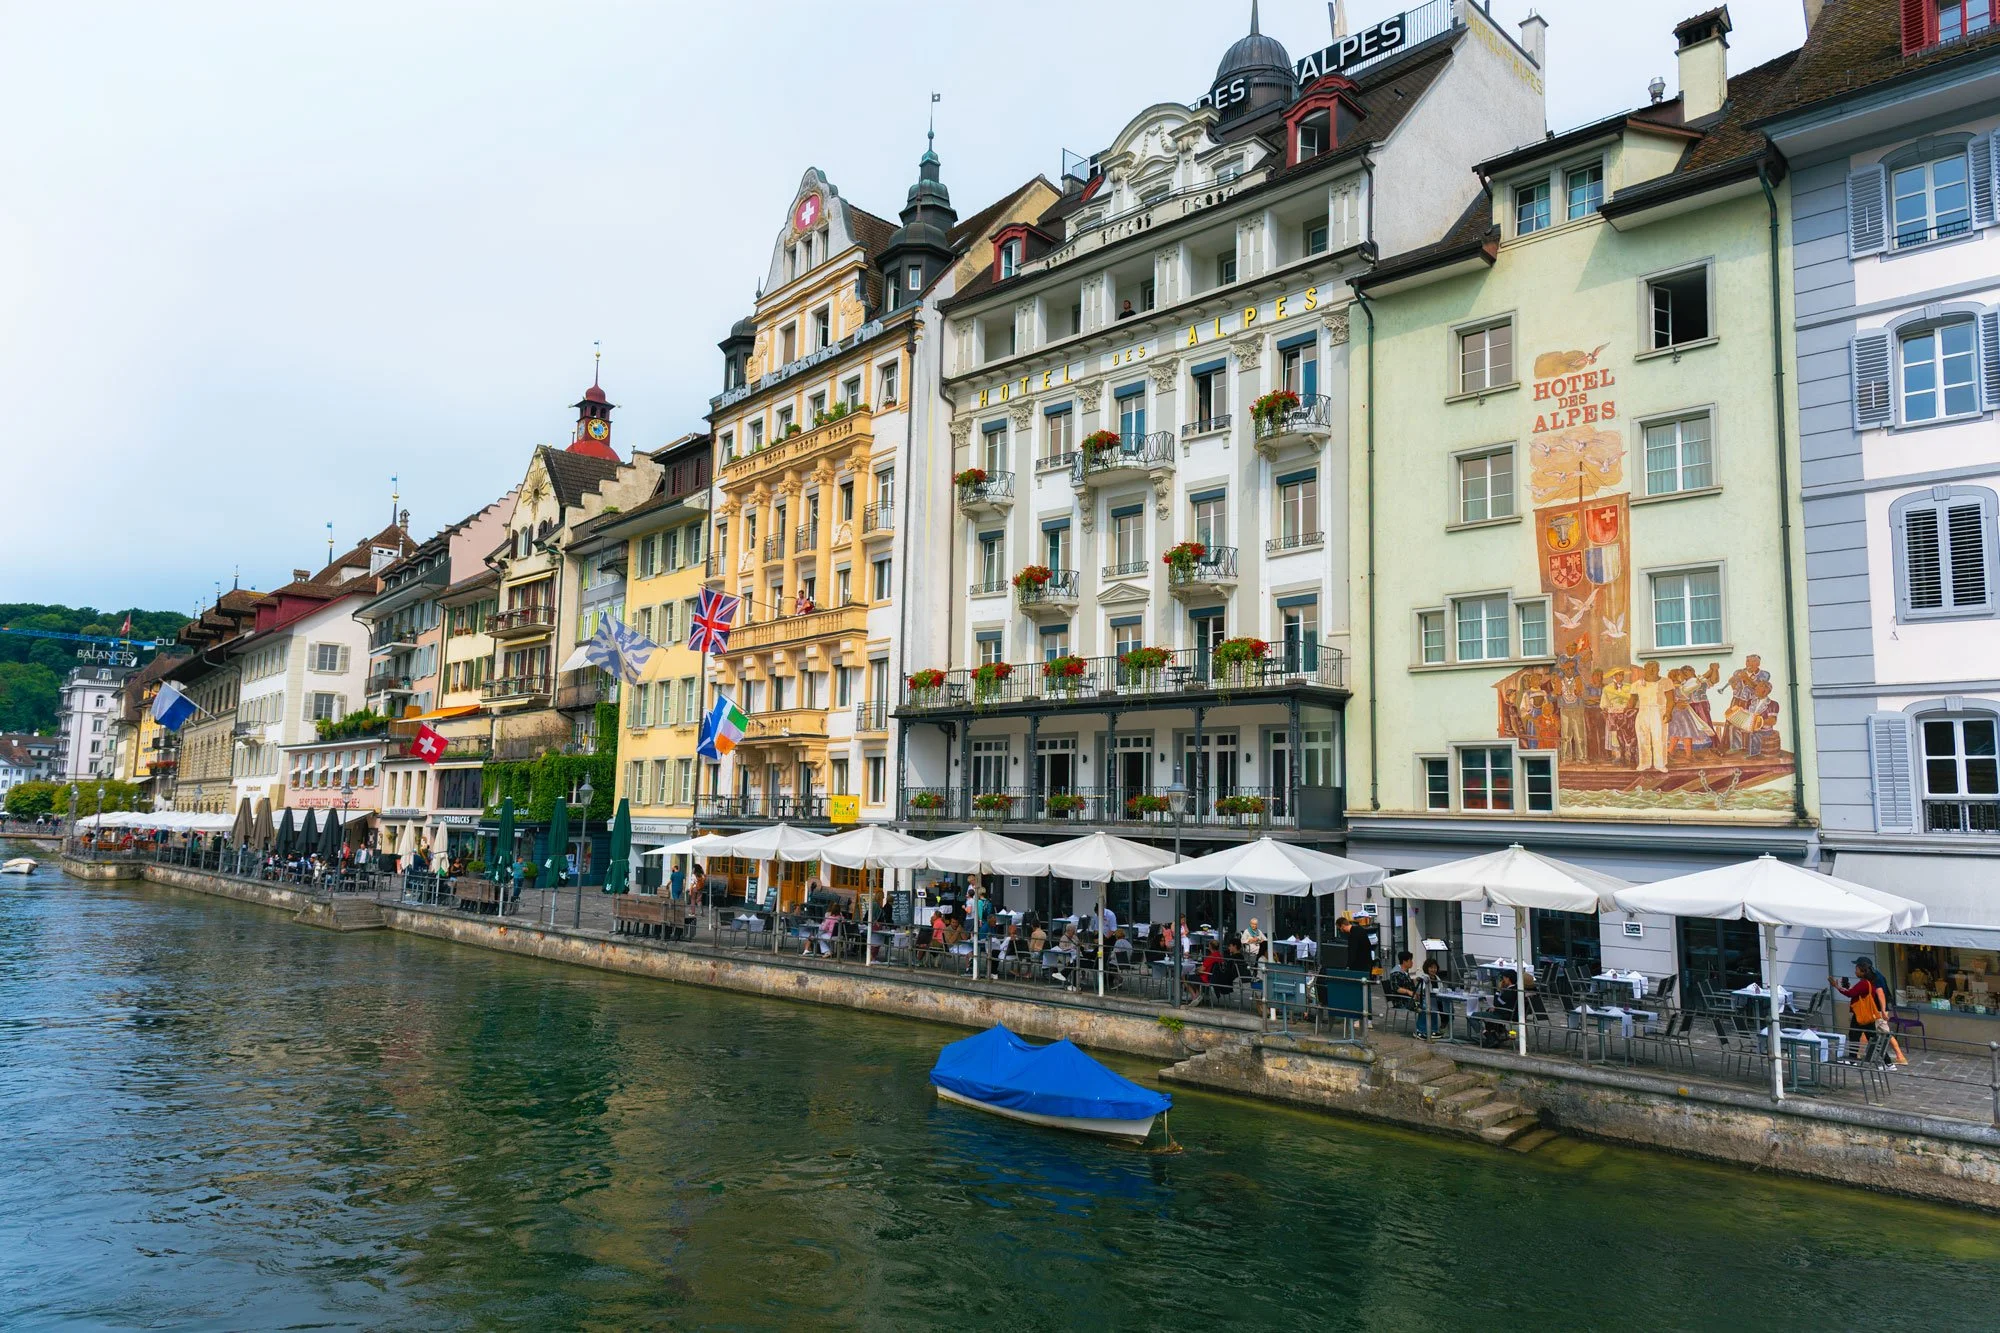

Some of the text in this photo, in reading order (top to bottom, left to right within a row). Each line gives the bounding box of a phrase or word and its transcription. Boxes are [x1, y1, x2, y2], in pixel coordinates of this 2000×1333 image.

[1299, 16, 1401, 86] ALPES
[721, 383, 751, 409] Hotel
[853, 319, 883, 346] Pub
[979, 287, 1318, 408] HOTEL DES ALPES
[1533, 368, 1615, 401] HOTEL
[1558, 392, 1587, 409] DES
[1532, 400, 1616, 433] ALPES
[77, 648, 134, 661] BALANCES
[443, 814, 470, 825] STARBUCKS
